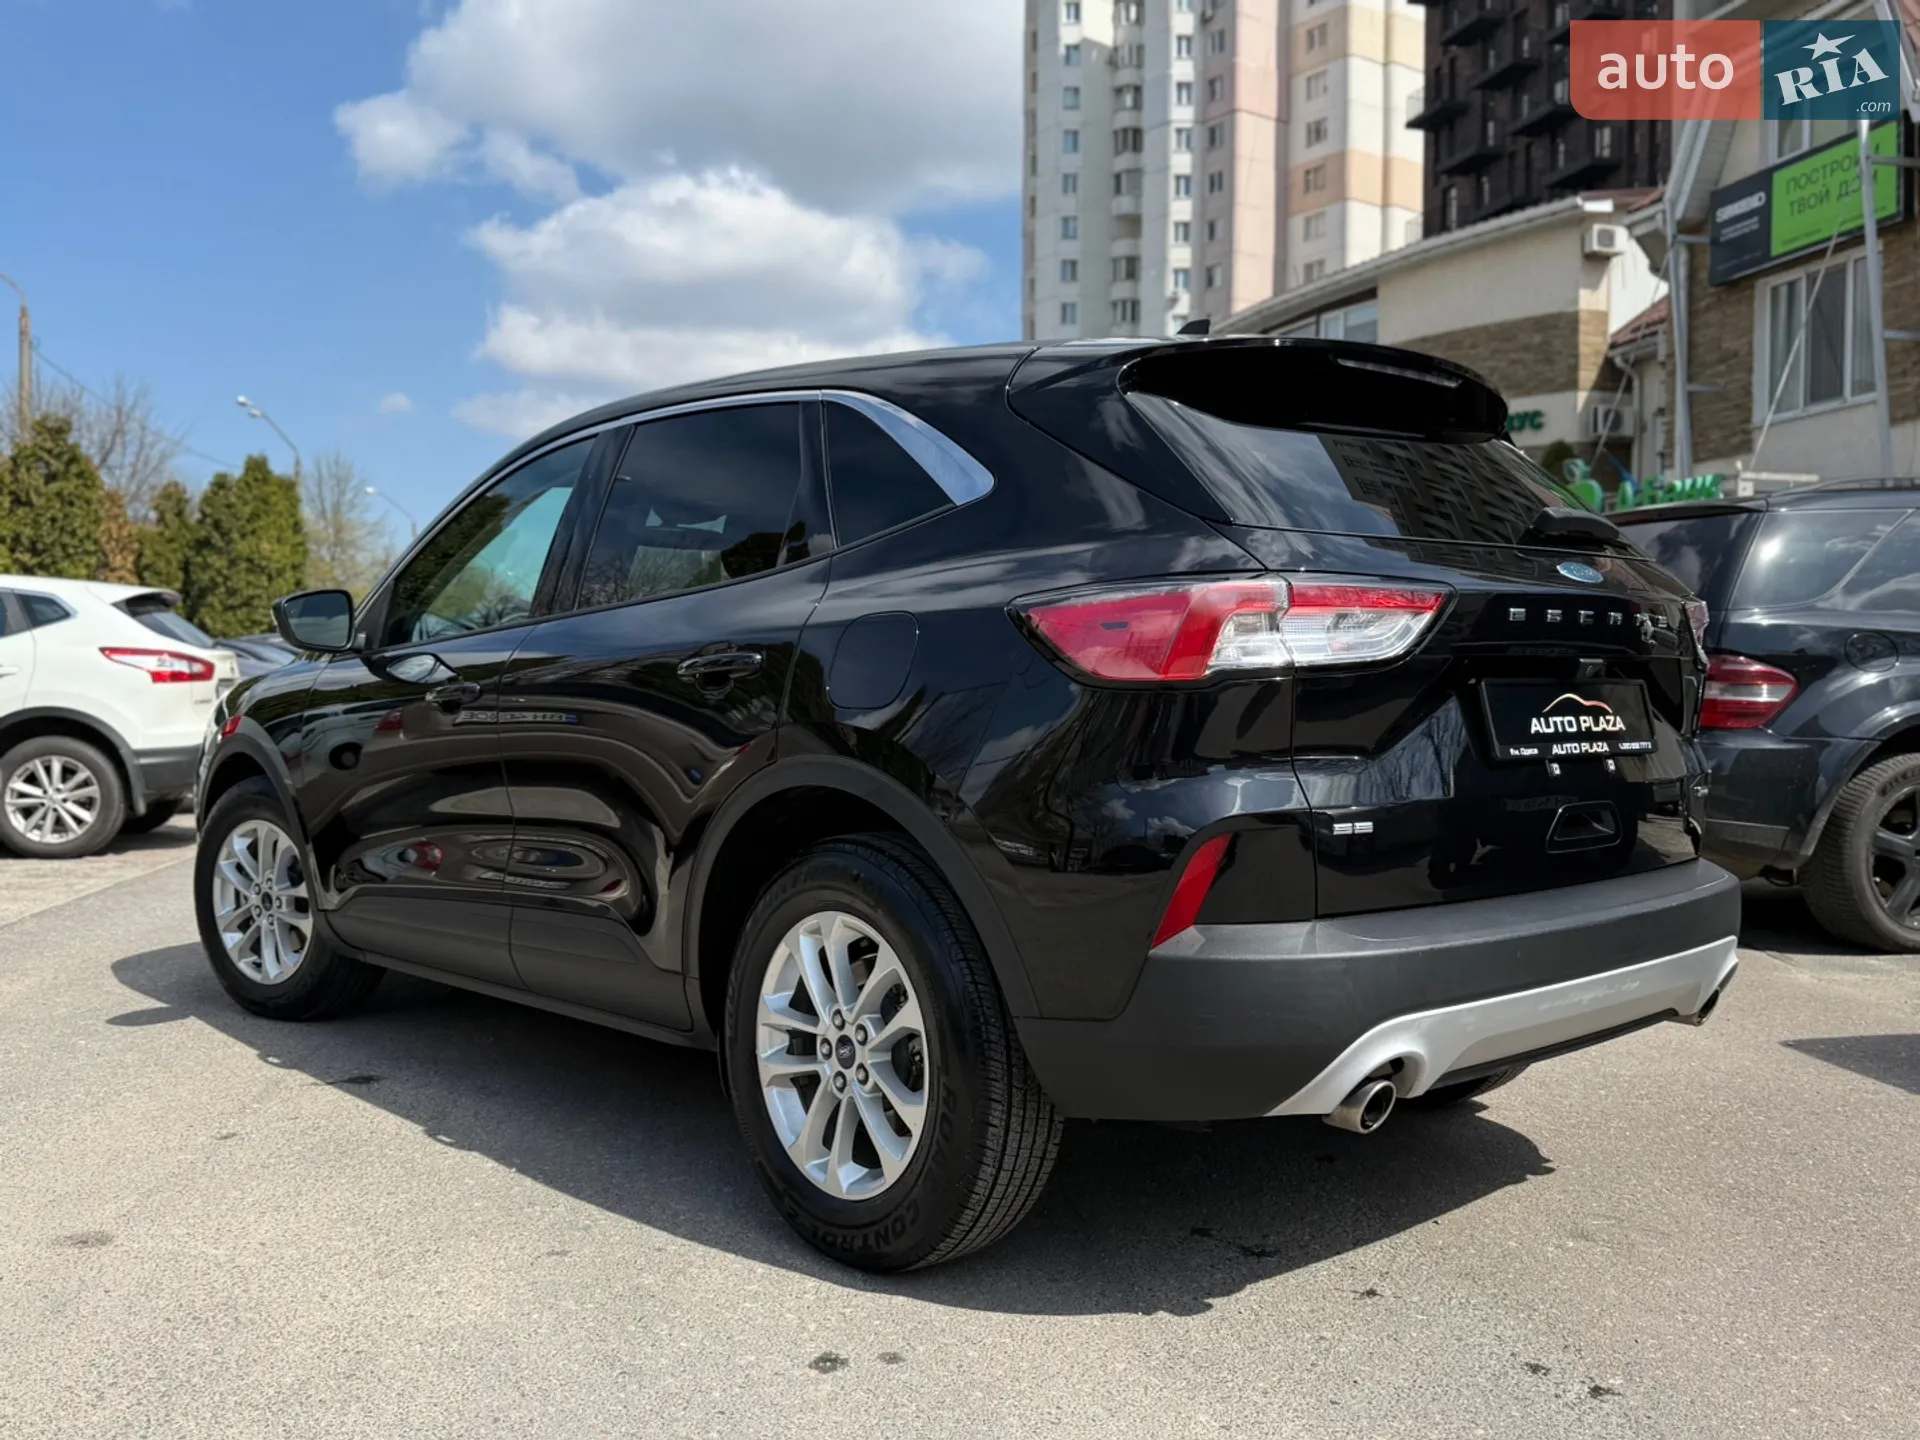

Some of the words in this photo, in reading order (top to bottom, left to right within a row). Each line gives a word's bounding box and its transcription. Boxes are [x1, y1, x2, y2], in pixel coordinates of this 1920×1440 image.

[1786, 142, 1880, 196] ПОСТРО
[1789, 186, 1831, 218] ТВОЙ
[1836, 169, 1878, 202] ДО
[1530, 716, 1577, 734] AUTO
[1580, 715, 1626, 733] PLAZA
[1552, 743, 1580, 755] AUTO
[1581, 742, 1609, 754] PLAZA
[809, 1198, 921, 1253] CONTROL
